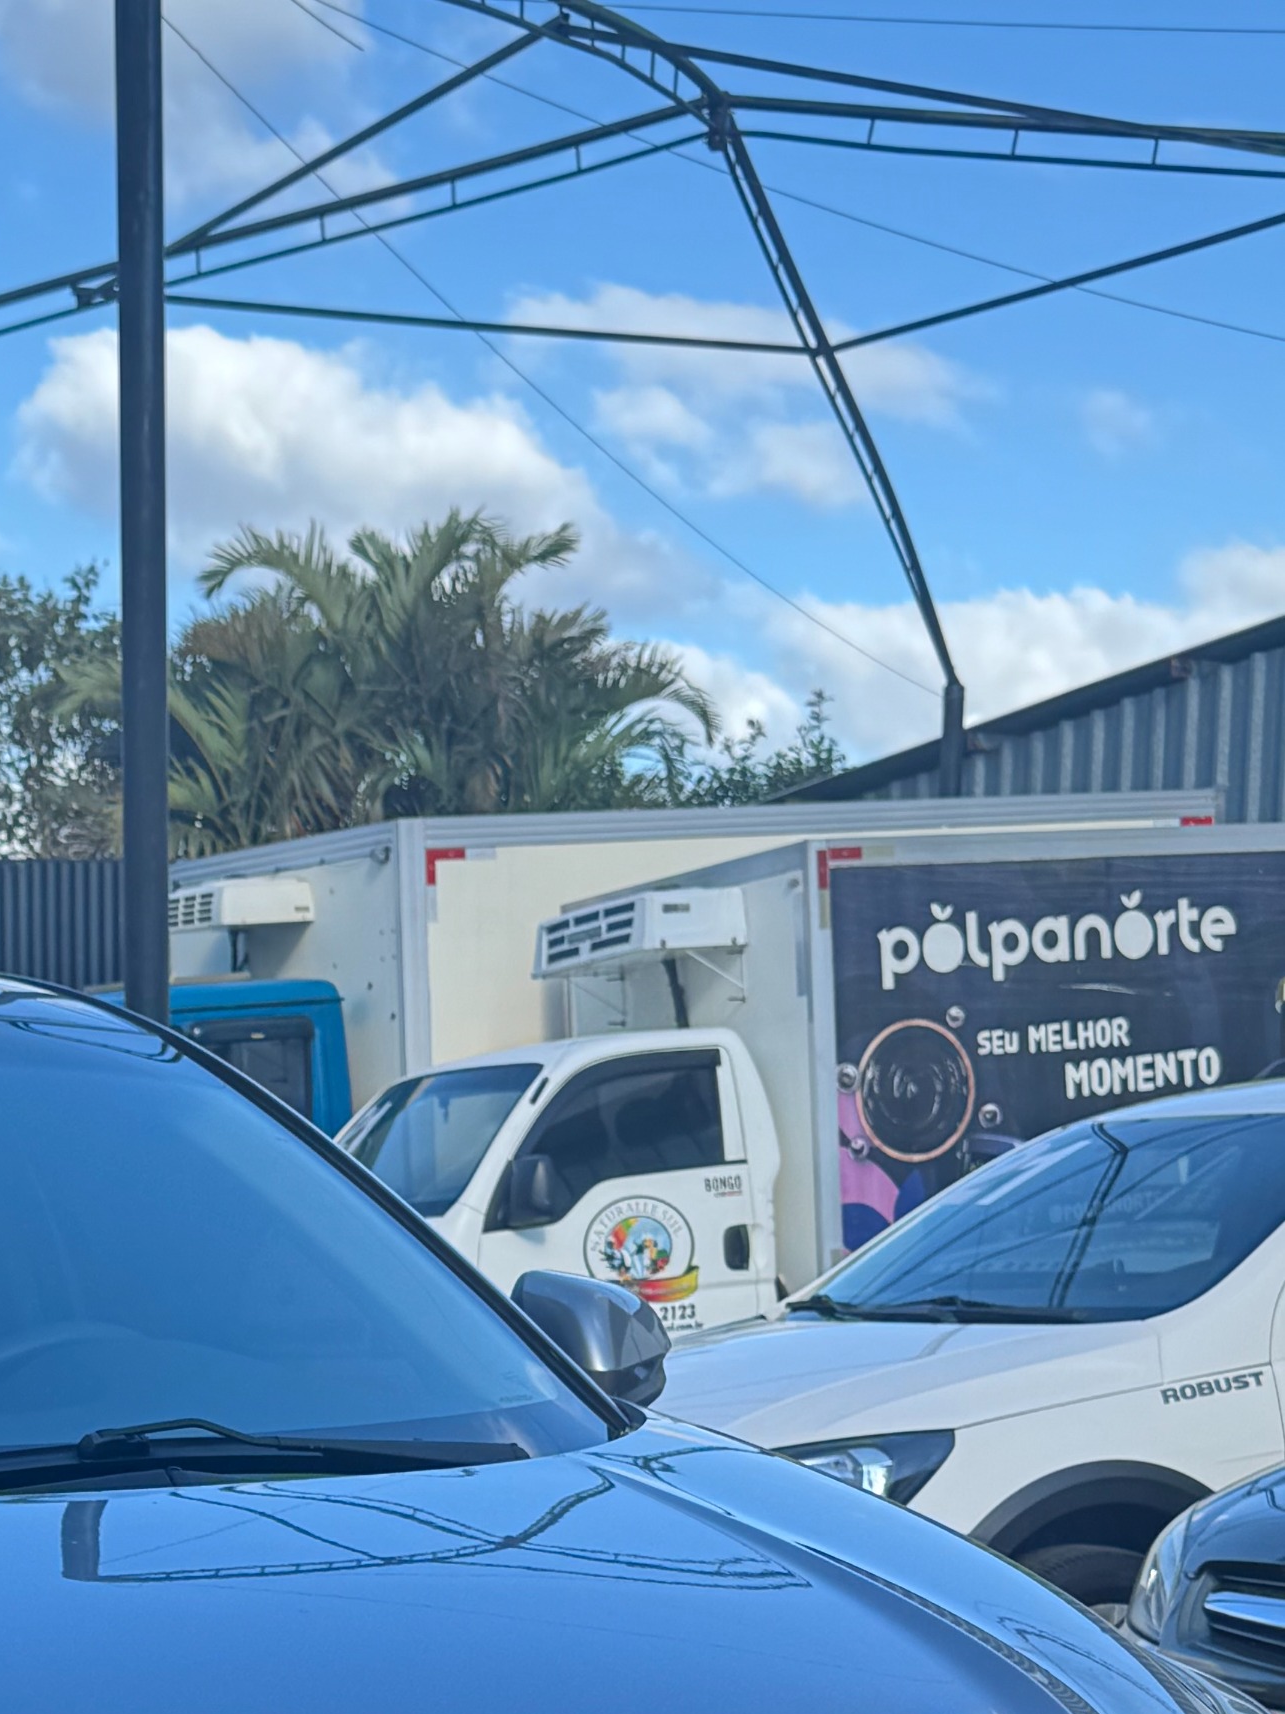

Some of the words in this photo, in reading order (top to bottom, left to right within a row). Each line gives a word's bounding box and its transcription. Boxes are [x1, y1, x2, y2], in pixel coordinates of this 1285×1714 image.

[877, 890, 1237, 990] polpanorte
[977, 1029, 1019, 1055] SEU
[1028, 1017, 1130, 1053] MELHOR
[1065, 1047, 1220, 1099] MOMENTO
[704, 1175, 742, 1193] BONGO
[1160, 1371, 1264, 1405] ROBUST
